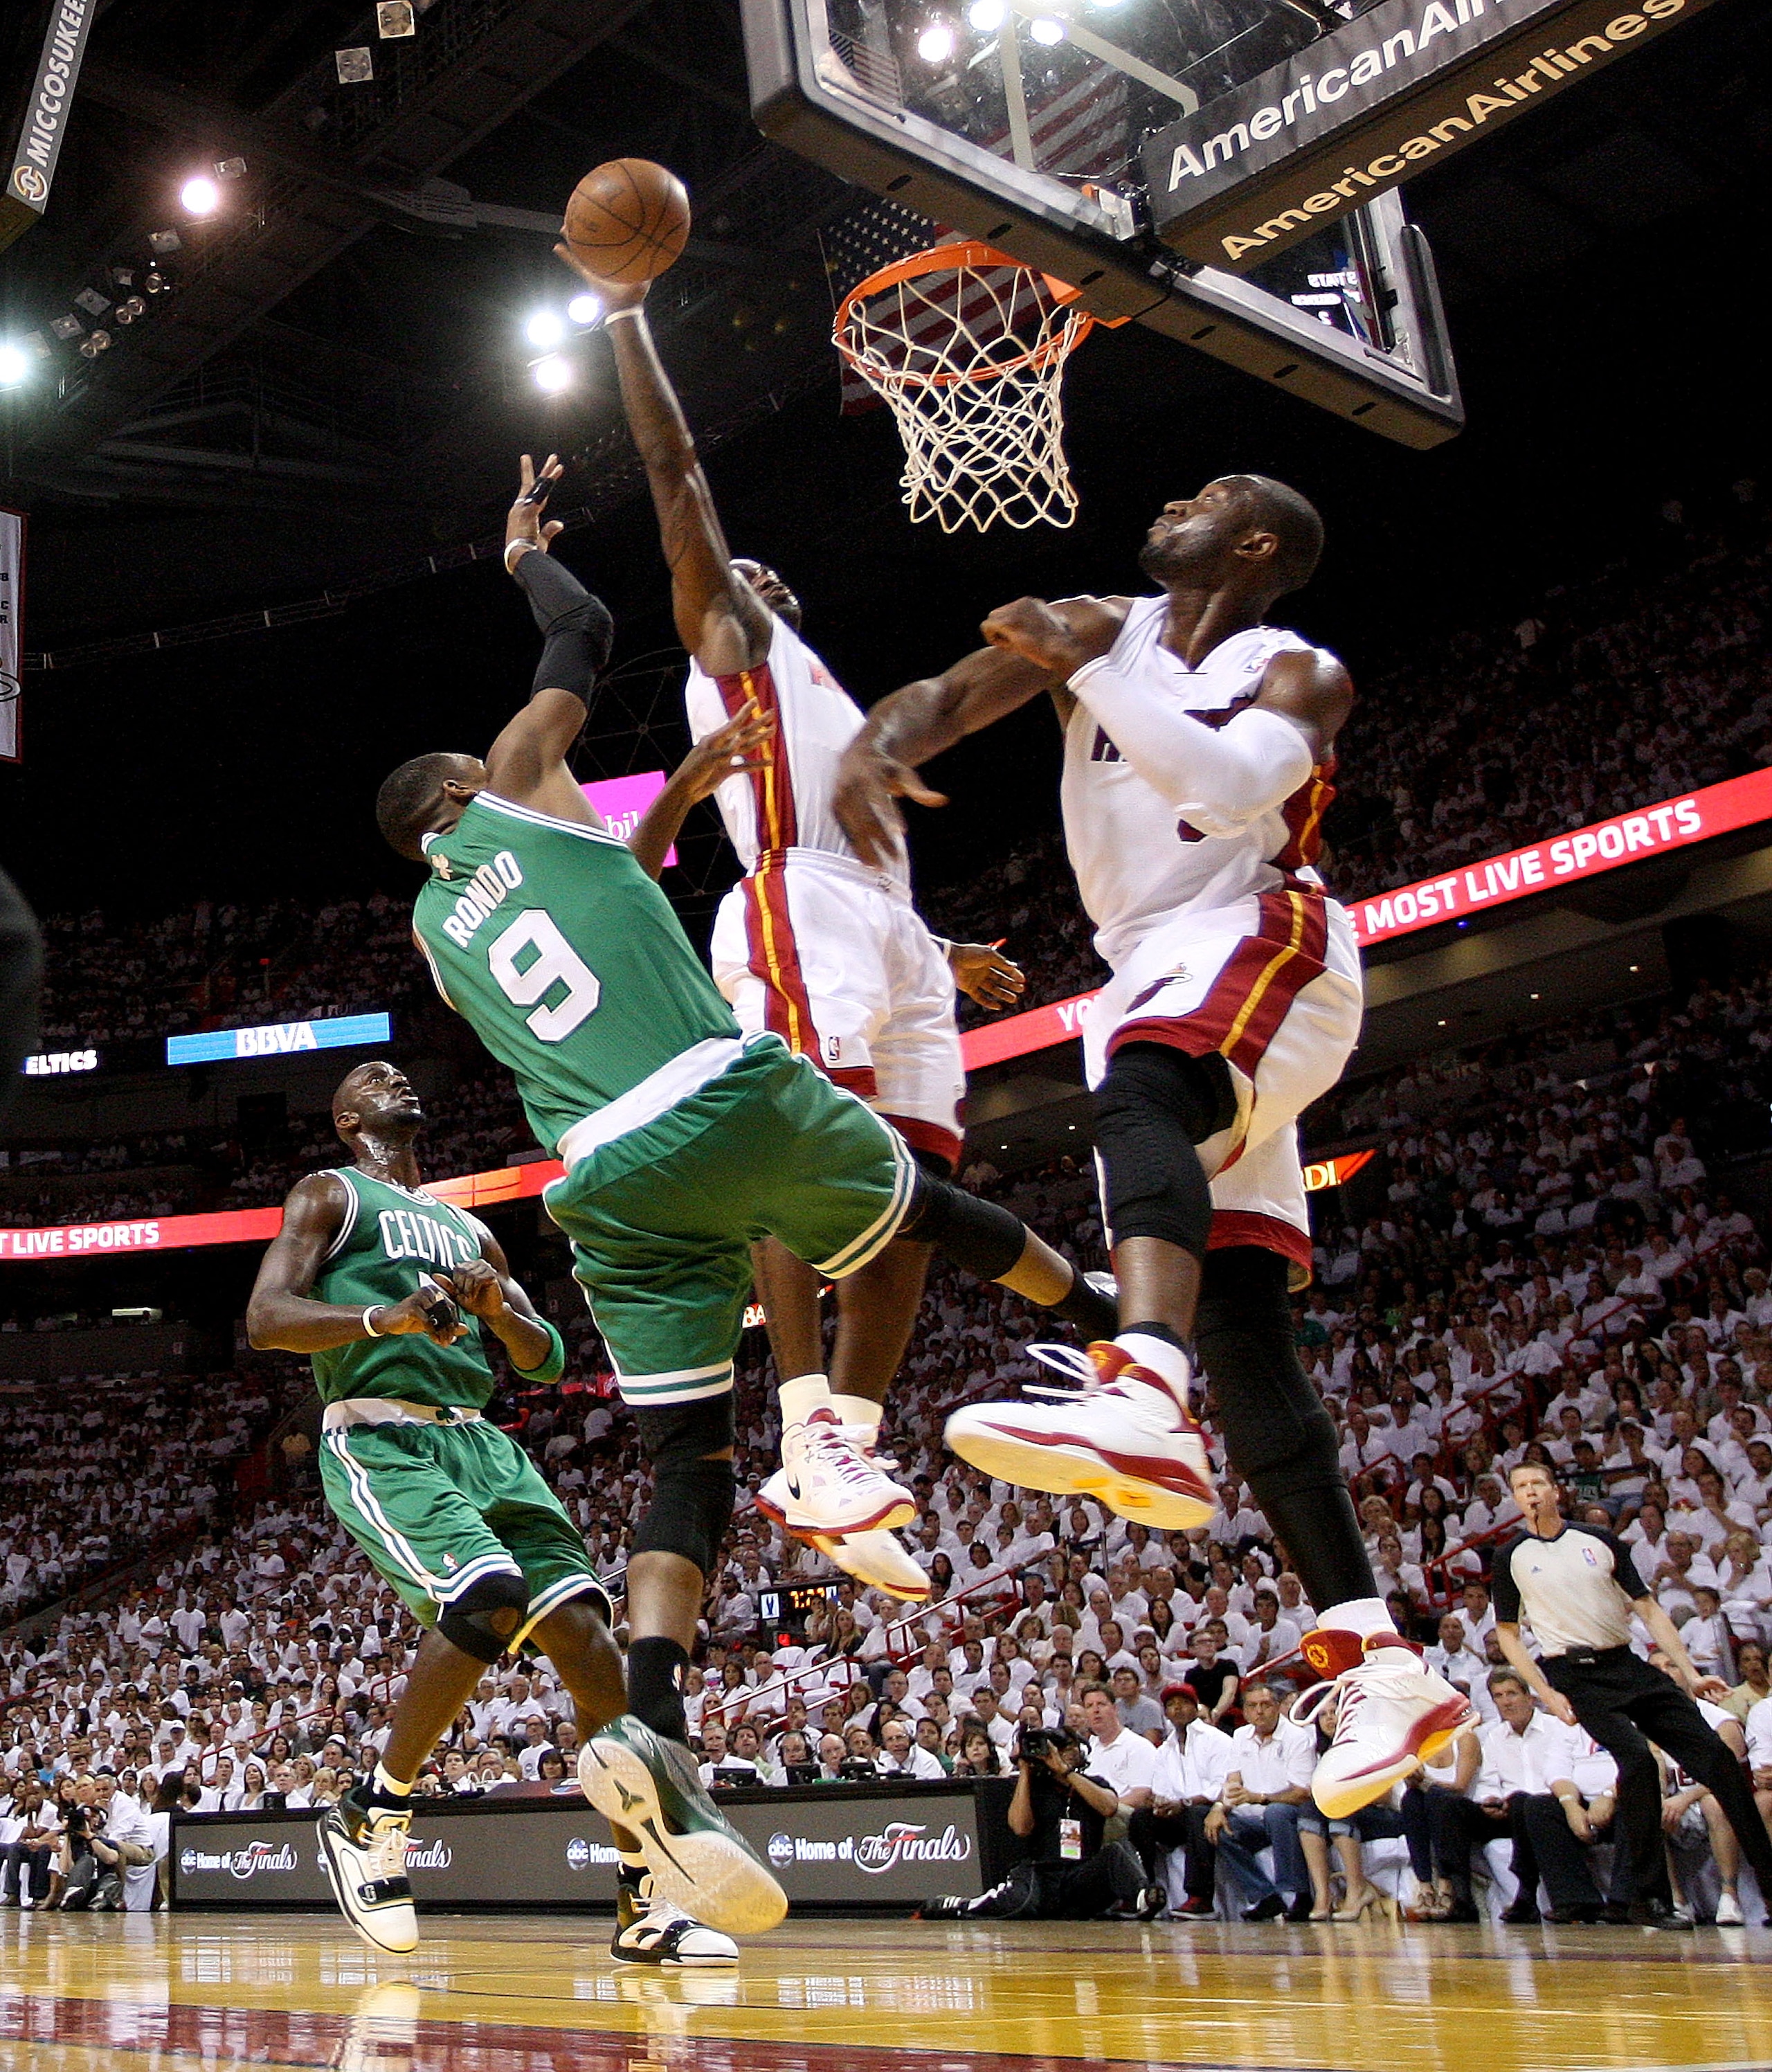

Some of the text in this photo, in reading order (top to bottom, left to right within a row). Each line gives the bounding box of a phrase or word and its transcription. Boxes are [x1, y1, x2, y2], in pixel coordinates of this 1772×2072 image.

[26, 0, 87, 167] MICCOSUKEE
[1220, 0, 1685, 261] AmericanAirlines
[441, 850, 524, 948] RONDO
[1364, 876, 1460, 935] MOST
[1465, 849, 1545, 903] LIVE
[1553, 799, 1701, 875] SPORTS
[487, 908, 602, 1043] 9
[236, 1021, 318, 1057] BBVA
[13, 1230, 64, 1254] LIVE
[68, 1222, 160, 1250] SPORTS
[197, 1852, 221, 1869] Home
[230, 1840, 298, 1880] Finals
[589, 1843, 621, 1863] Hom
[768, 1839, 794, 1856] abc
[795, 1837, 836, 1860] Home
[838, 1836, 853, 1859] of
[854, 1821, 970, 1873] Finals
